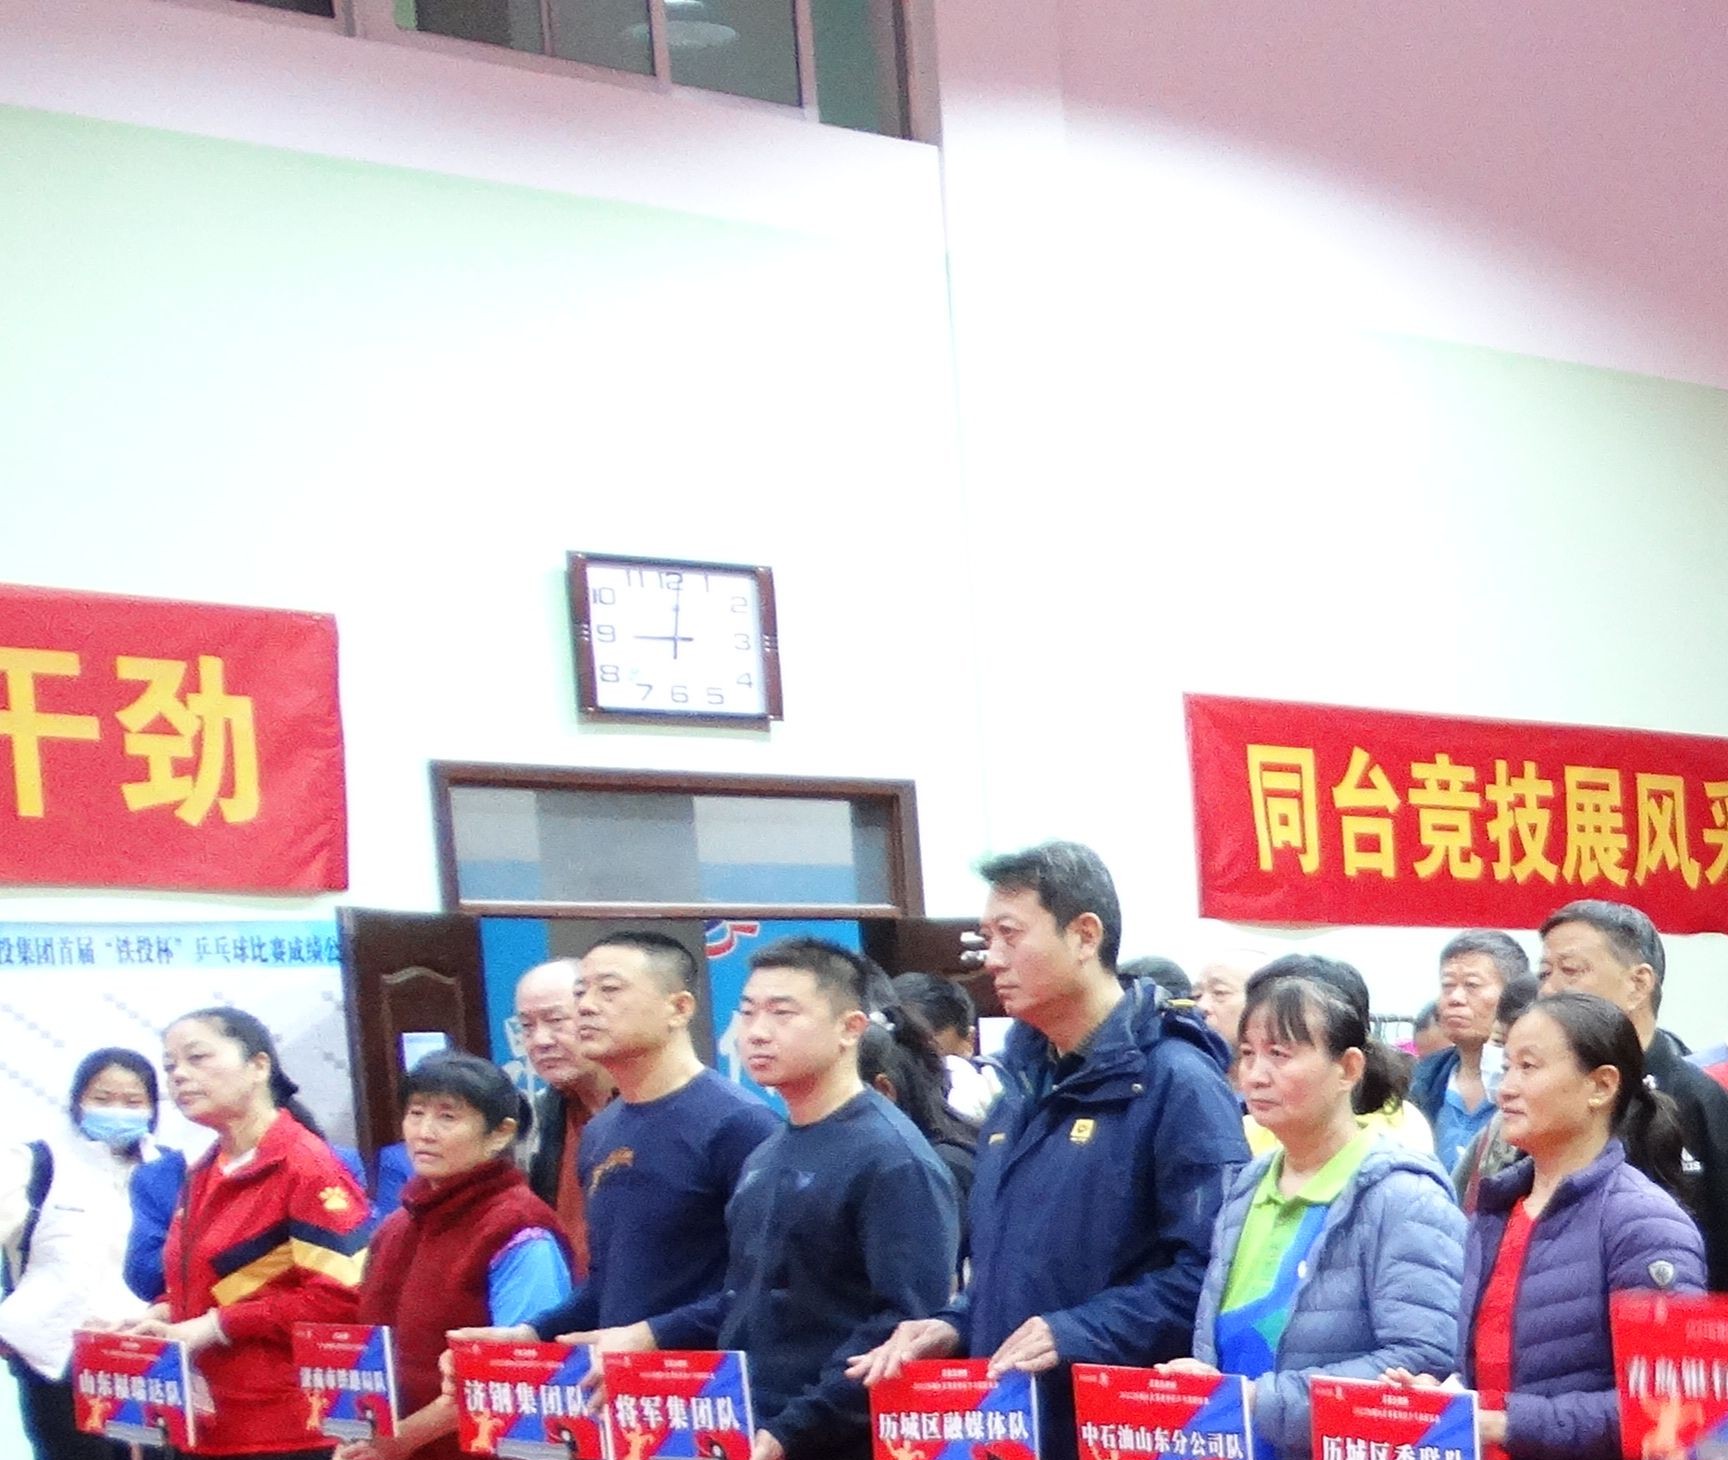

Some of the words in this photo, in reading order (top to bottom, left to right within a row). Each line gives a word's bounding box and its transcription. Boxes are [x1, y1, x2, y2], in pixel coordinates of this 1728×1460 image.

[658, 571, 684, 591] 12
[592, 587, 616, 605] 10
[731, 596, 748, 613] 2
[597, 624, 616, 643] 9
[734, 633, 751, 651] 3
[600, 664, 620, 683] 8
[736, 672, 753, 689] 4
[636, 683, 653, 701] 7
[671, 686, 689, 704] 6
[706, 687, 724, 705] 5
[0, 646, 263, 828] 干劲
[464, 1379, 590, 1418] 济钢集团队
[614, 1393, 742, 1432] 将军集团队
[878, 1409, 1030, 1442] 历城区融媒体队
[1080, 1423, 1245, 1460] 中石油山东分公司队
